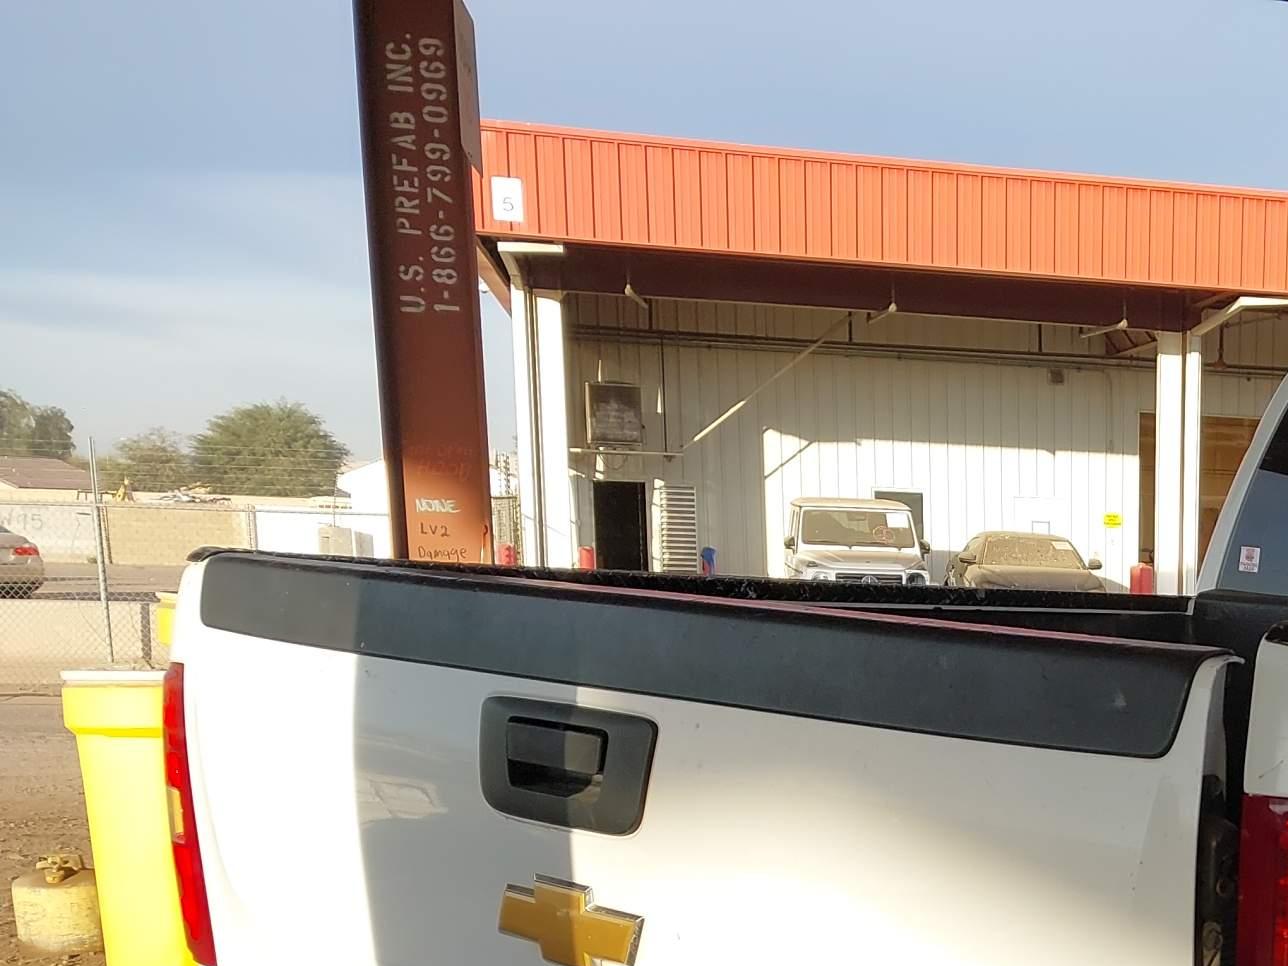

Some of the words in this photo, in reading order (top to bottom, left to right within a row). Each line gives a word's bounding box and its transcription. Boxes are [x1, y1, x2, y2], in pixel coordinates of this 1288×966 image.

[385, 32, 413, 93] INC.
[389, 110, 422, 236] PREFAB
[418, 37, 460, 312] 1-866-799-0969
[503, 196, 514, 213] 5
[400, 257, 425, 313] U.S.
[417, 546, 468, 561] Damage
